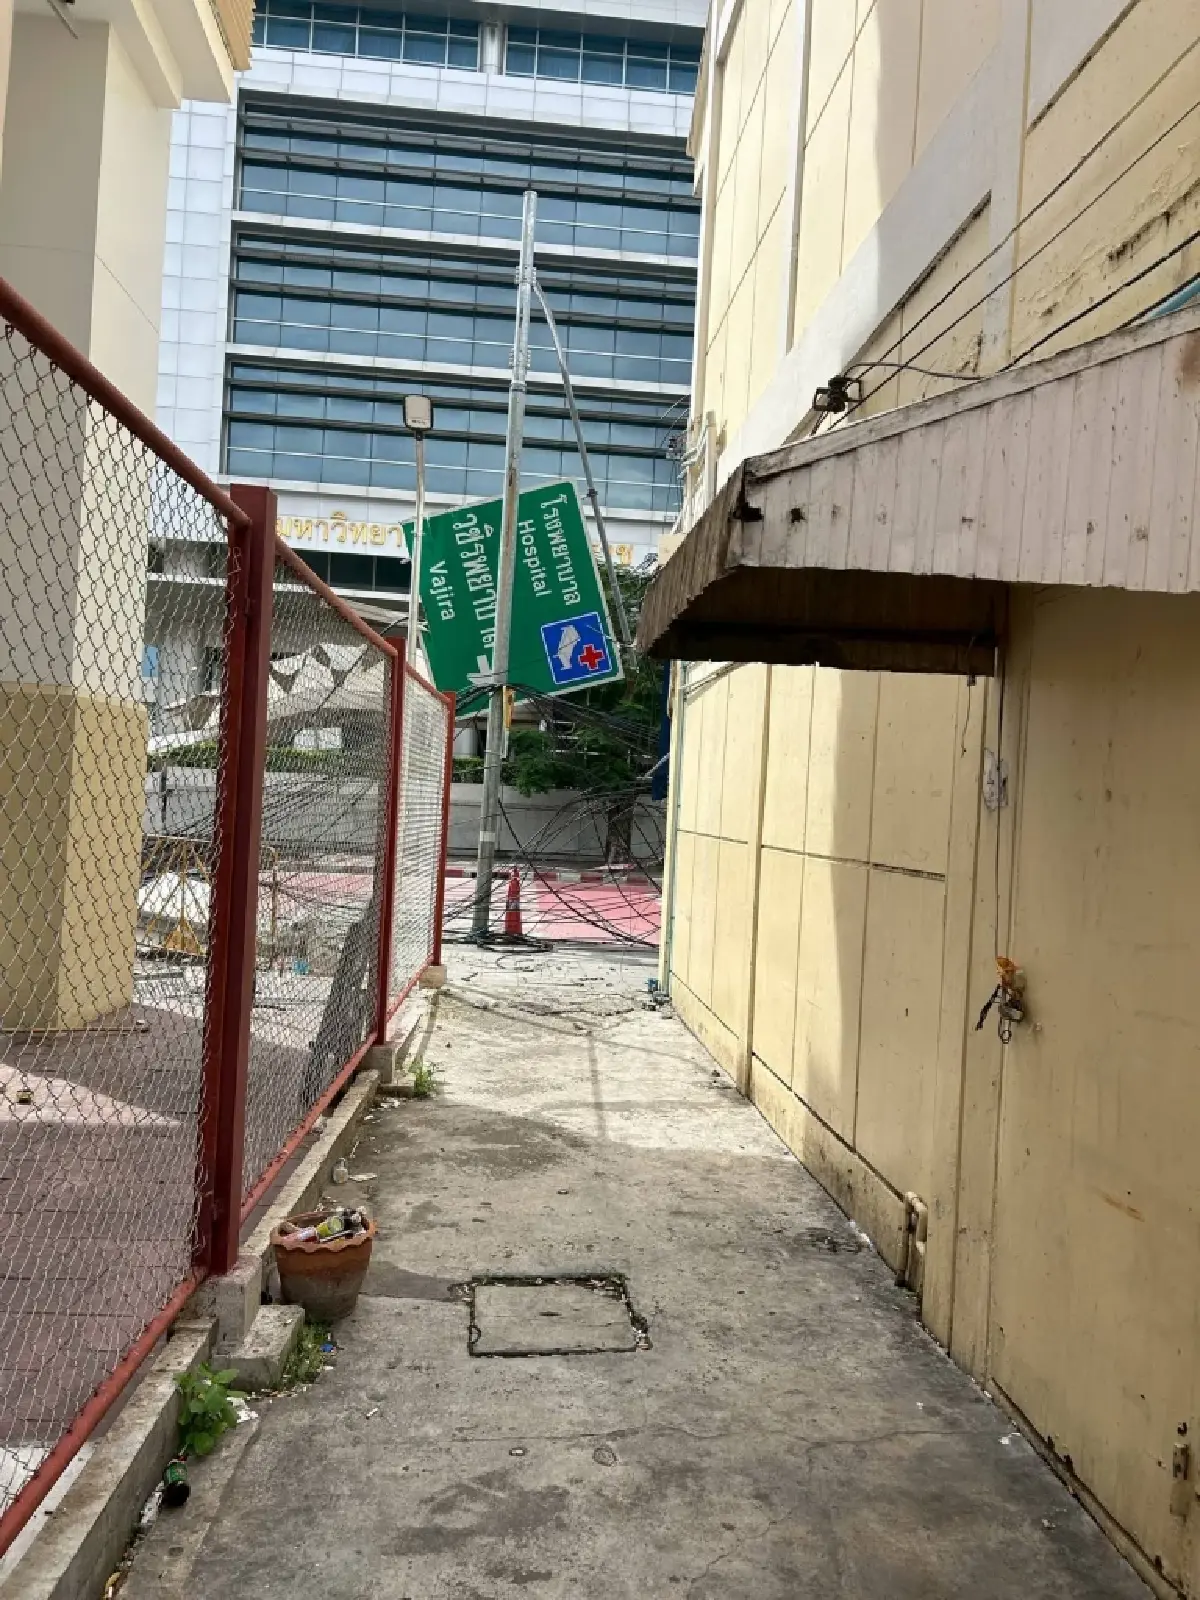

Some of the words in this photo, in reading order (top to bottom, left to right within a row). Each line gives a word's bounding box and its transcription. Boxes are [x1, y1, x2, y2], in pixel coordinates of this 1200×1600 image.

[518, 519, 553, 598] Hospital
[540, 493, 581, 606] โรงพยาบาล
[429, 560, 456, 621] Vajira
